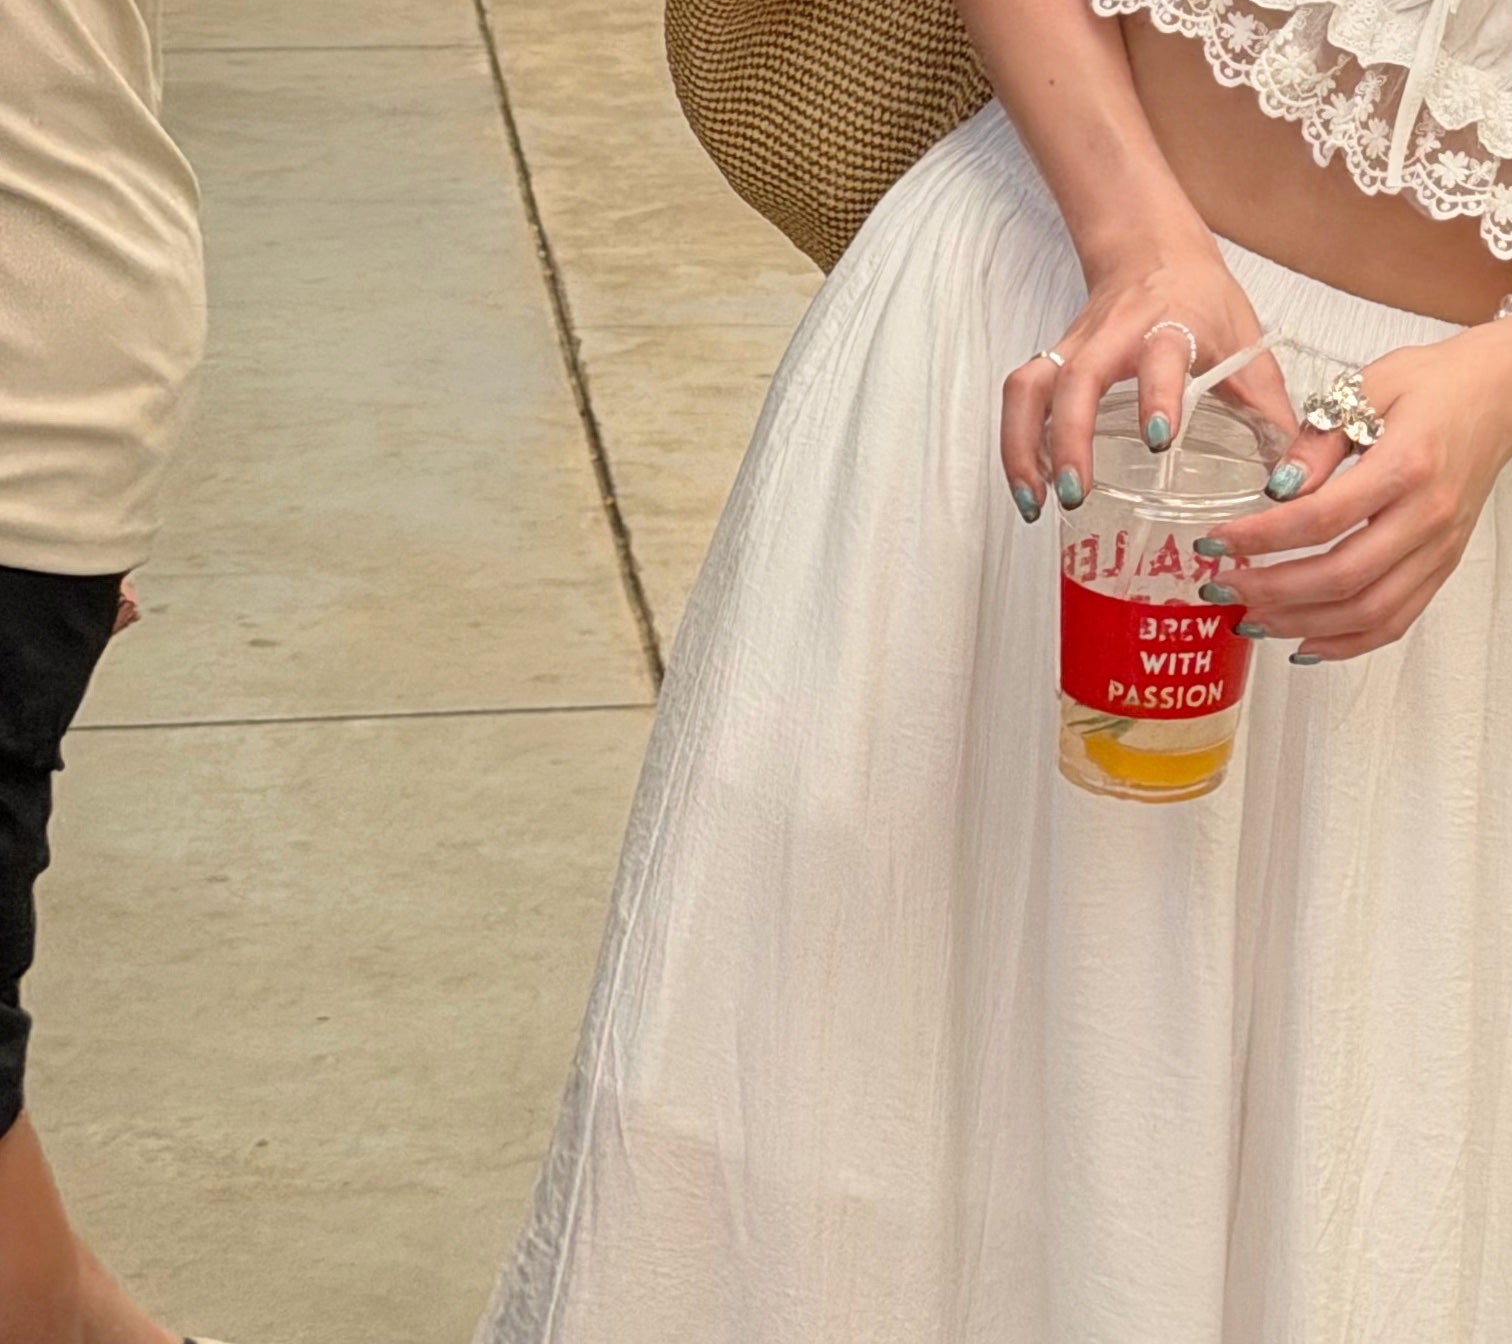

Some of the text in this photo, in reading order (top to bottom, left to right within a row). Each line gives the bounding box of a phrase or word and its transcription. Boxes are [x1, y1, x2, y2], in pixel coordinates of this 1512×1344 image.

[1139, 615, 1221, 642] BREW
[1139, 649, 1213, 676] WITH
[1107, 679, 1224, 709] PASSION
